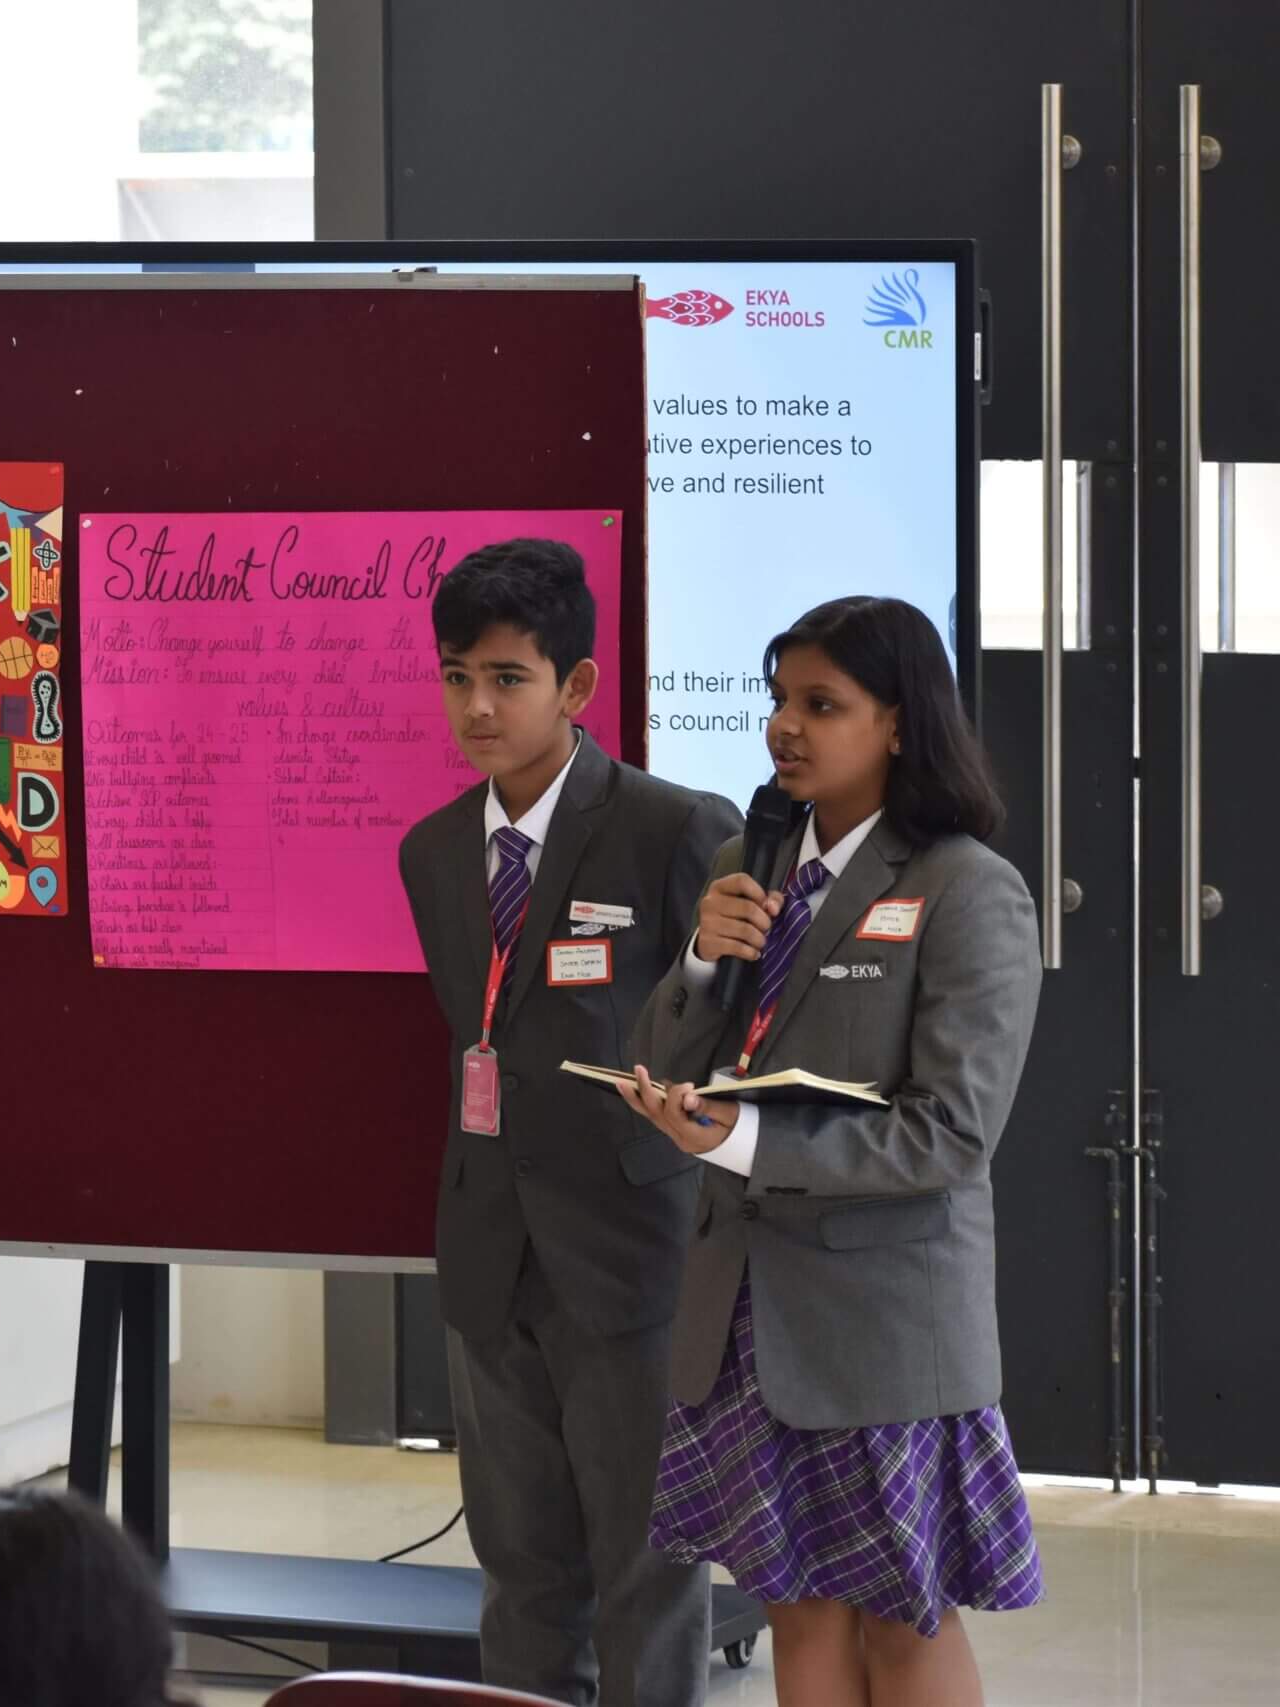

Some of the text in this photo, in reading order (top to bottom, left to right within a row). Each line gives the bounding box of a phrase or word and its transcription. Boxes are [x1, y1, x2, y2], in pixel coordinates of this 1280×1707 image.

[745, 290, 790, 306] EKYA
[745, 311, 825, 328] SCHOOLS
[883, 330, 933, 349] CMR
[653, 393, 852, 417] values to make a
[701, 433, 842, 461] experiences
[851, 437, 872, 456] to
[647, 472, 825, 495] ve and resilient
[104, 524, 265, 602] Student
[270, 525, 391, 601] Council
[404, 536, 446, 600] Ch
[276, 621, 296, 651] to
[387, 616, 414, 651] the
[648, 671, 767, 693] nd their im
[237, 691, 290, 718] values
[321, 690, 385, 718] culture
[670, 711, 749, 732] council
[21, 776, 55, 828] D
[851, 965, 882, 978] EKYA
